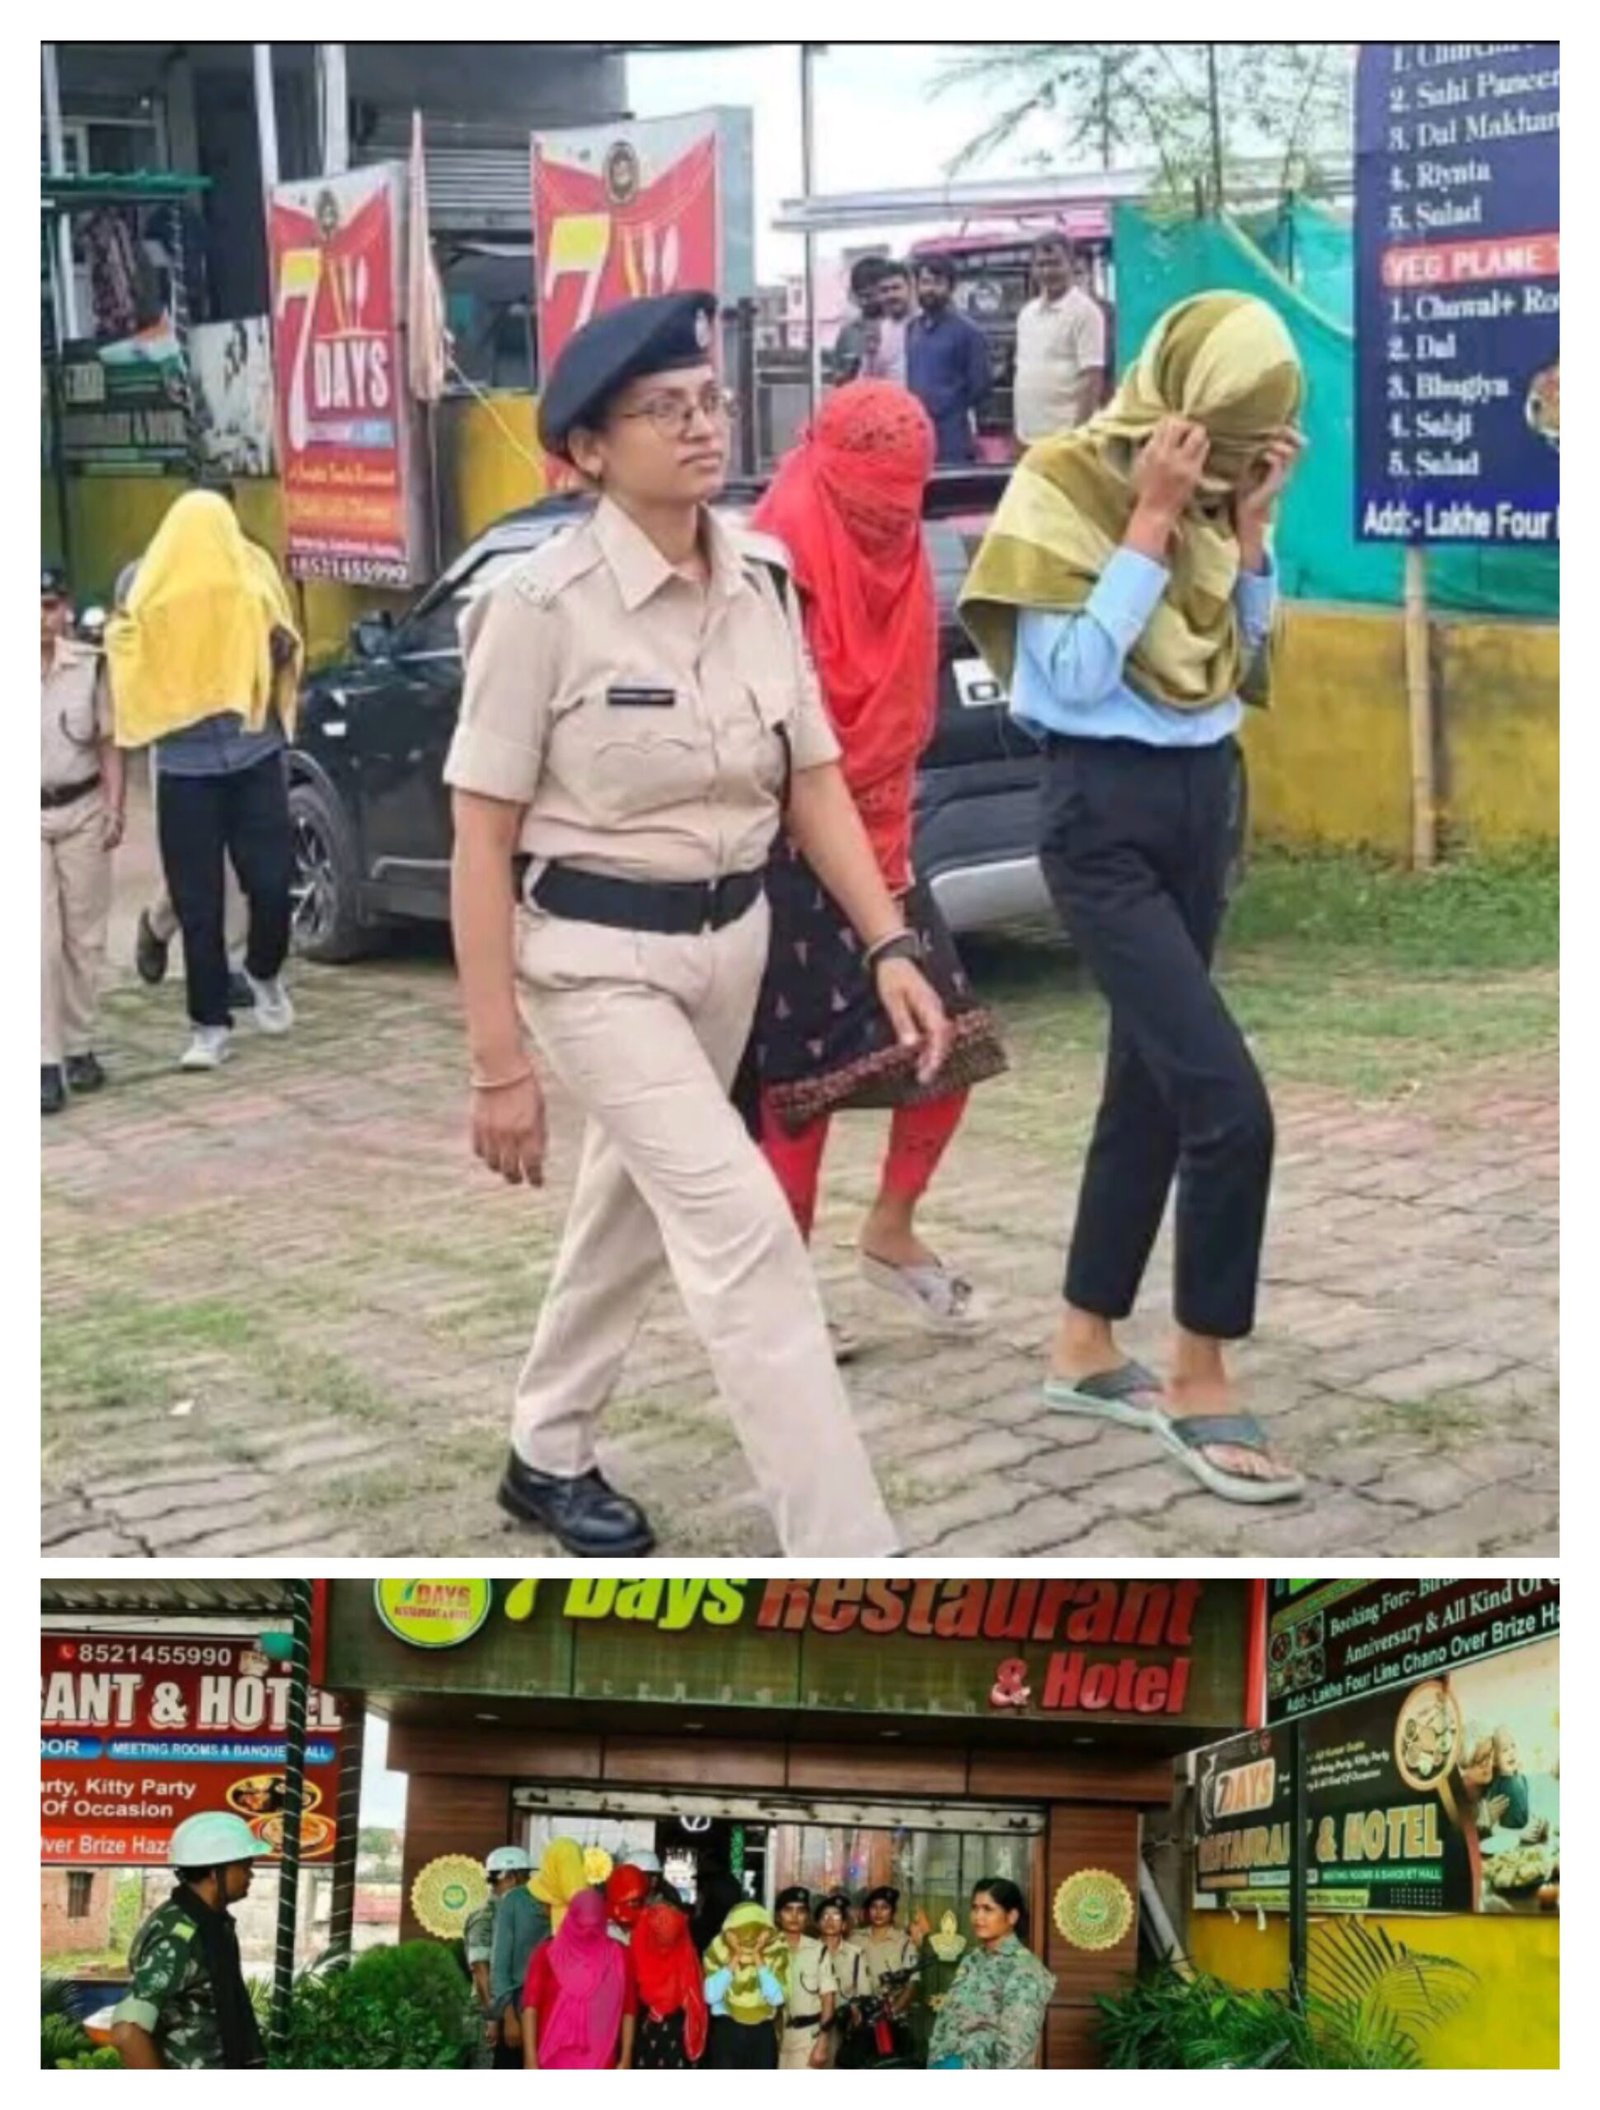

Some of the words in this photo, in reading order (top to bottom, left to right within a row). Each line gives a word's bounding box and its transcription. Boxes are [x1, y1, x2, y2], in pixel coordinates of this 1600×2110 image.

[1417, 119, 1457, 148] Dal
[1416, 197, 1482, 231] Salad
[1388, 254, 1441, 286] VEG
[275, 247, 322, 452] 7
[1388, 336, 1410, 361] 2.
[1416, 333, 1456, 359] Dal
[313, 337, 392, 410] DAYS
[1388, 374, 1410, 399] 3.
[1388, 451, 1410, 476] 5.
[1416, 450, 1480, 476] Salad
[1425, 502, 1491, 536] Lakhe
[1497, 503, 1550, 539] Four
[563, 1579, 748, 1629] Days
[757, 1579, 1202, 1646] Restaurant
[1330, 1602, 1380, 1637] Booking
[1344, 1620, 1424, 1666] Anniversary
[1425, 1611, 1439, 1634] &
[1442, 1597, 1466, 1629] All
[1469, 1579, 1513, 1616] Kind
[79, 1644, 232, 1666] 8521455990
[1345, 1673, 1372, 1694] Four
[1373, 1662, 1400, 1684] Line
[1402, 1645, 1447, 1674] Chano
[1450, 1630, 1487, 1658] Over
[1492, 1613, 1536, 1644] Brize
[990, 1658, 1031, 1708] &
[1042, 1652, 1191, 1713] Hotel
[41, 1671, 144, 1727] ANT
[150, 1682, 187, 1729] &
[111, 1741, 168, 1756] MEETING
[172, 1743, 219, 1756] ROOMS
[222, 1745, 230, 1756] &
[234, 1744, 286, 1758] BANQUE
[85, 1778, 134, 1799] Kitty
[141, 1779, 196, 1799] Party
[42, 1800, 68, 1817] Of
[73, 1800, 174, 1818] Occasion
[79, 1835, 126, 1855] Brize
[1316, 1816, 1337, 1862] &
[1343, 1803, 1443, 1861] HOTEL
[1418, 1866, 1443, 1880] HALL
